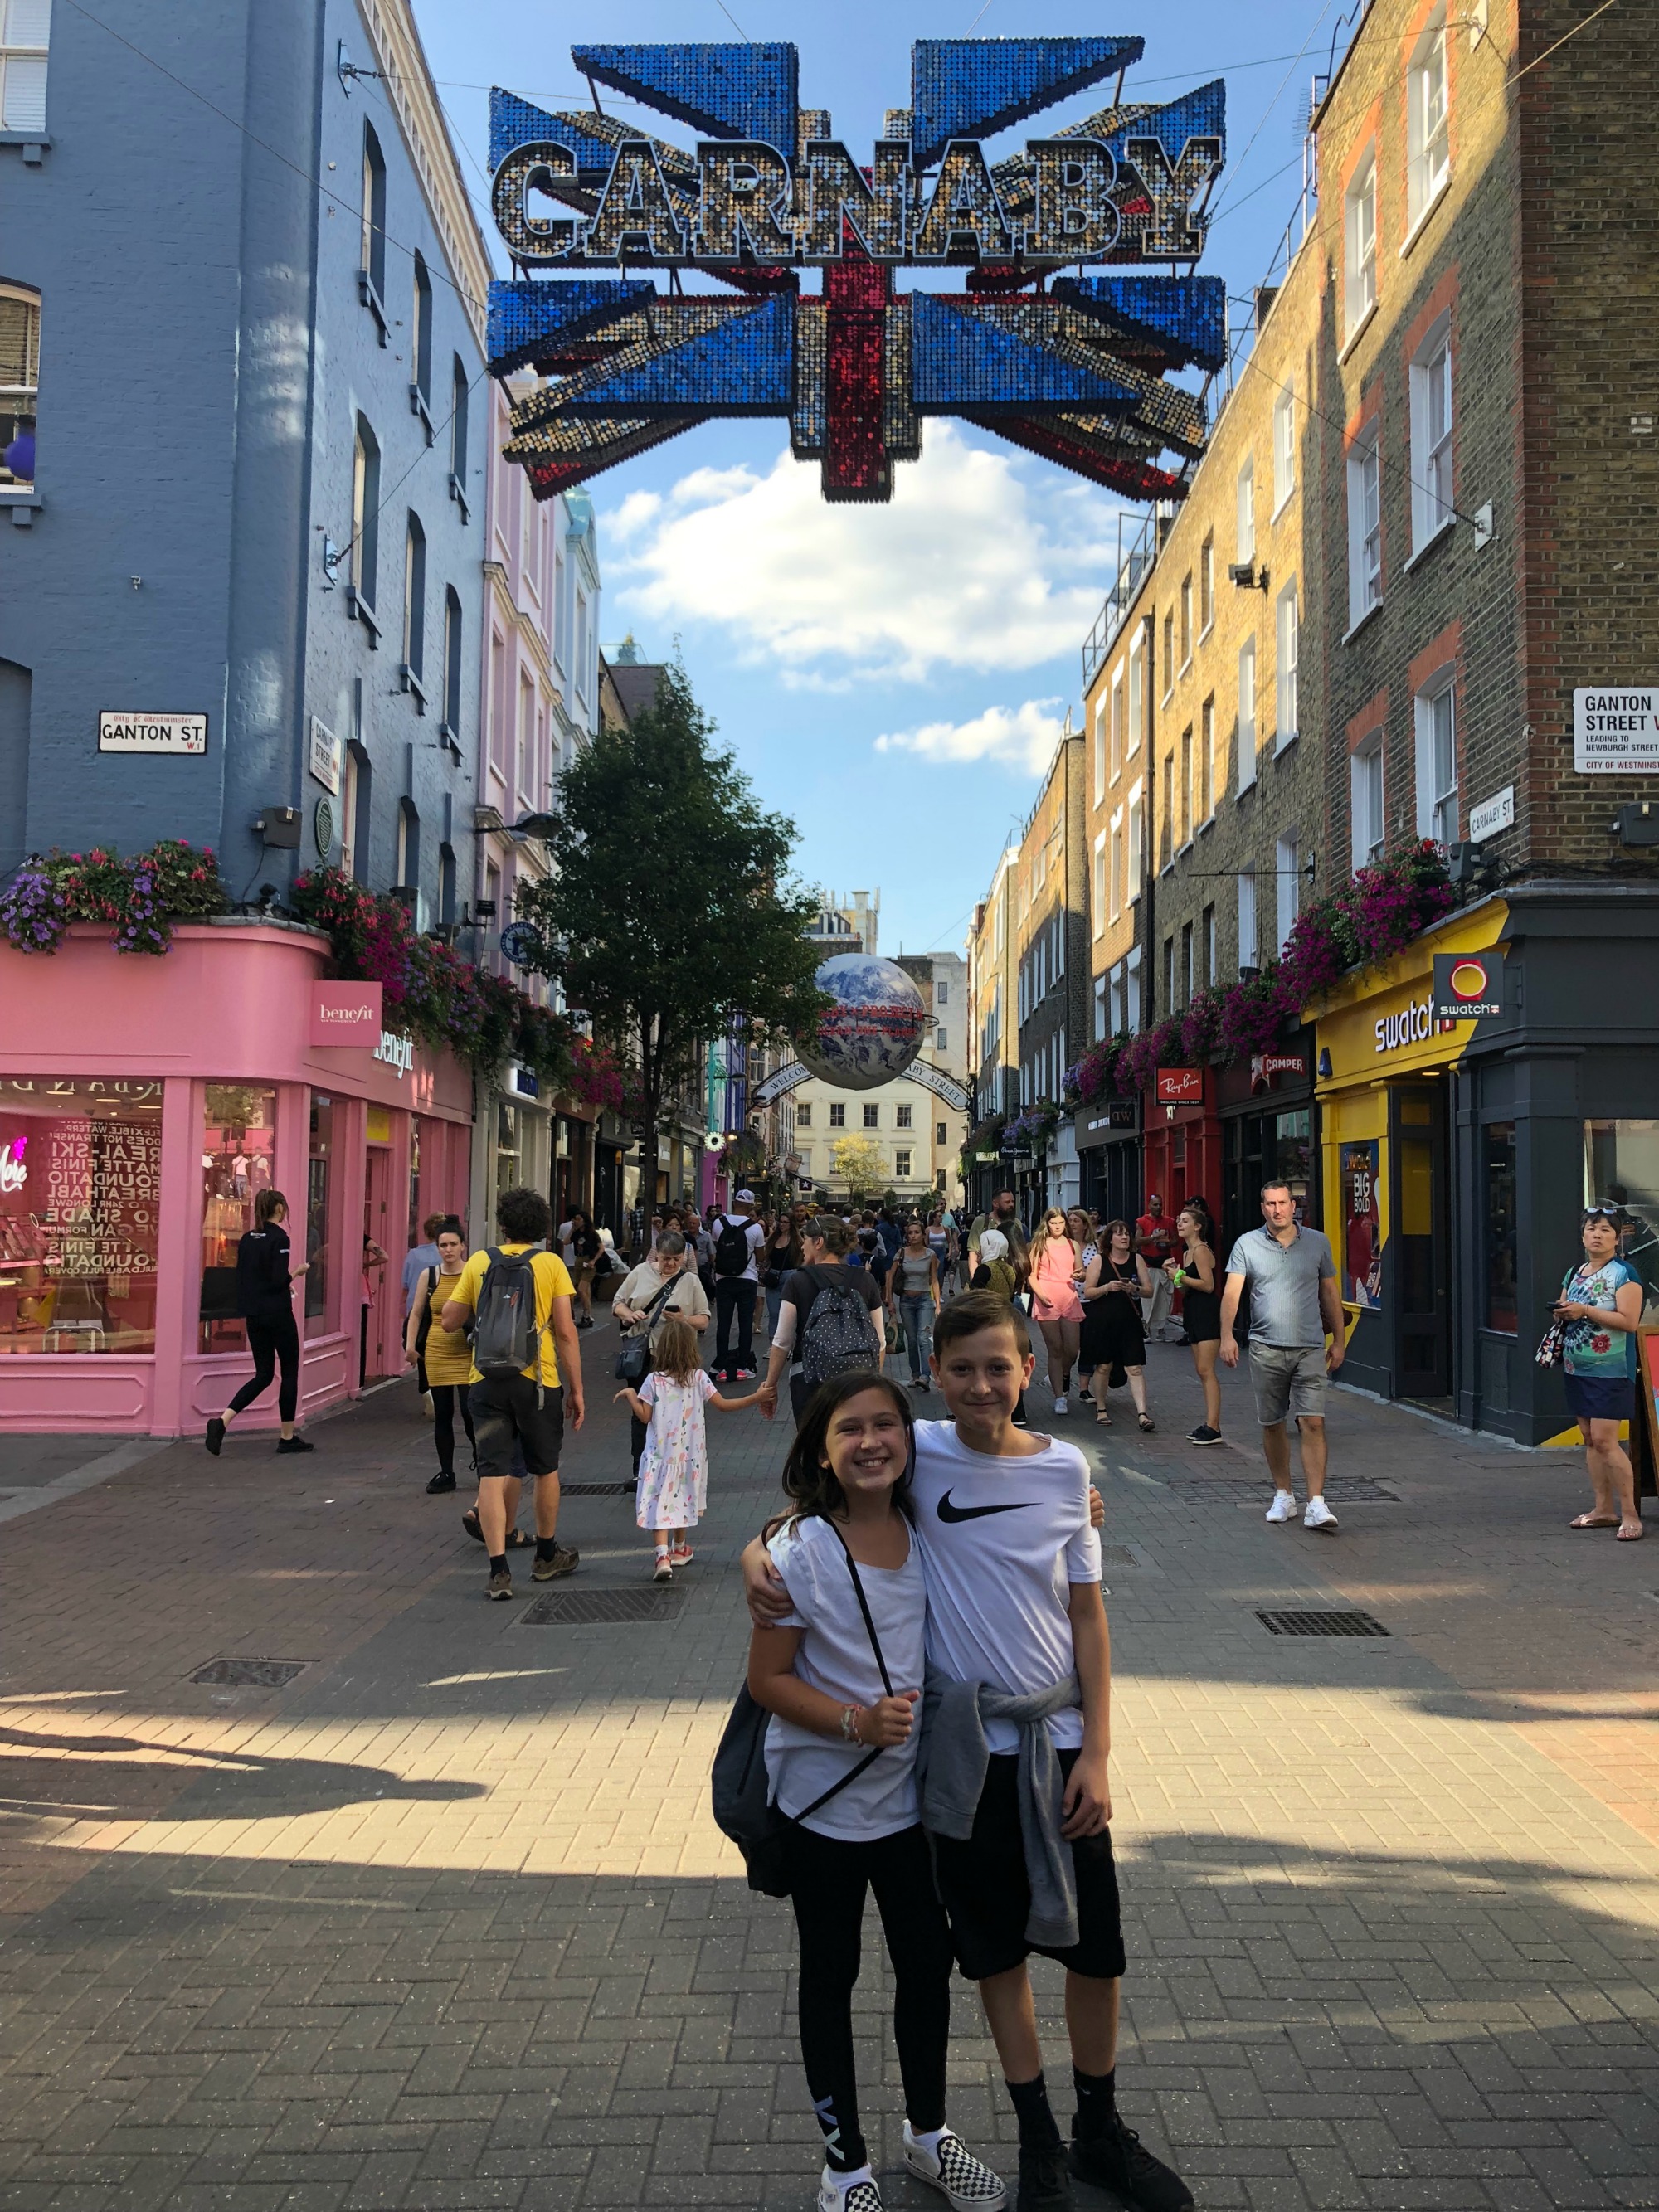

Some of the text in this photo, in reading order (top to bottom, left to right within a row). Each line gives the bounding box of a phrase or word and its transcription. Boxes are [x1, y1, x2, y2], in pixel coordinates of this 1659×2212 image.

[491, 135, 1224, 265] CARNABY
[1585, 696, 1651, 711] GANTON
[114, 715, 129, 723] City
[1586, 715, 1647, 731] STREET
[102, 724, 202, 741] GANTON ST.
[1586, 761, 1603, 770] CITY
[1605, 761, 1614, 770] OF
[1472, 804, 1501, 834] CARNABY
[1502, 798, 1512, 816] ST.
[320, 1004, 374, 1023] benefit
[1440, 1004, 1490, 1015] swatch
[1266, 1058, 1303, 1072] CAMPER
[929, 1075, 961, 1101] STREET
[1160, 1073, 1199, 1094] Ray-Ban
[1354, 1173, 1370, 1197] BIG
[1354, 1198, 1370, 1213] BOLD
